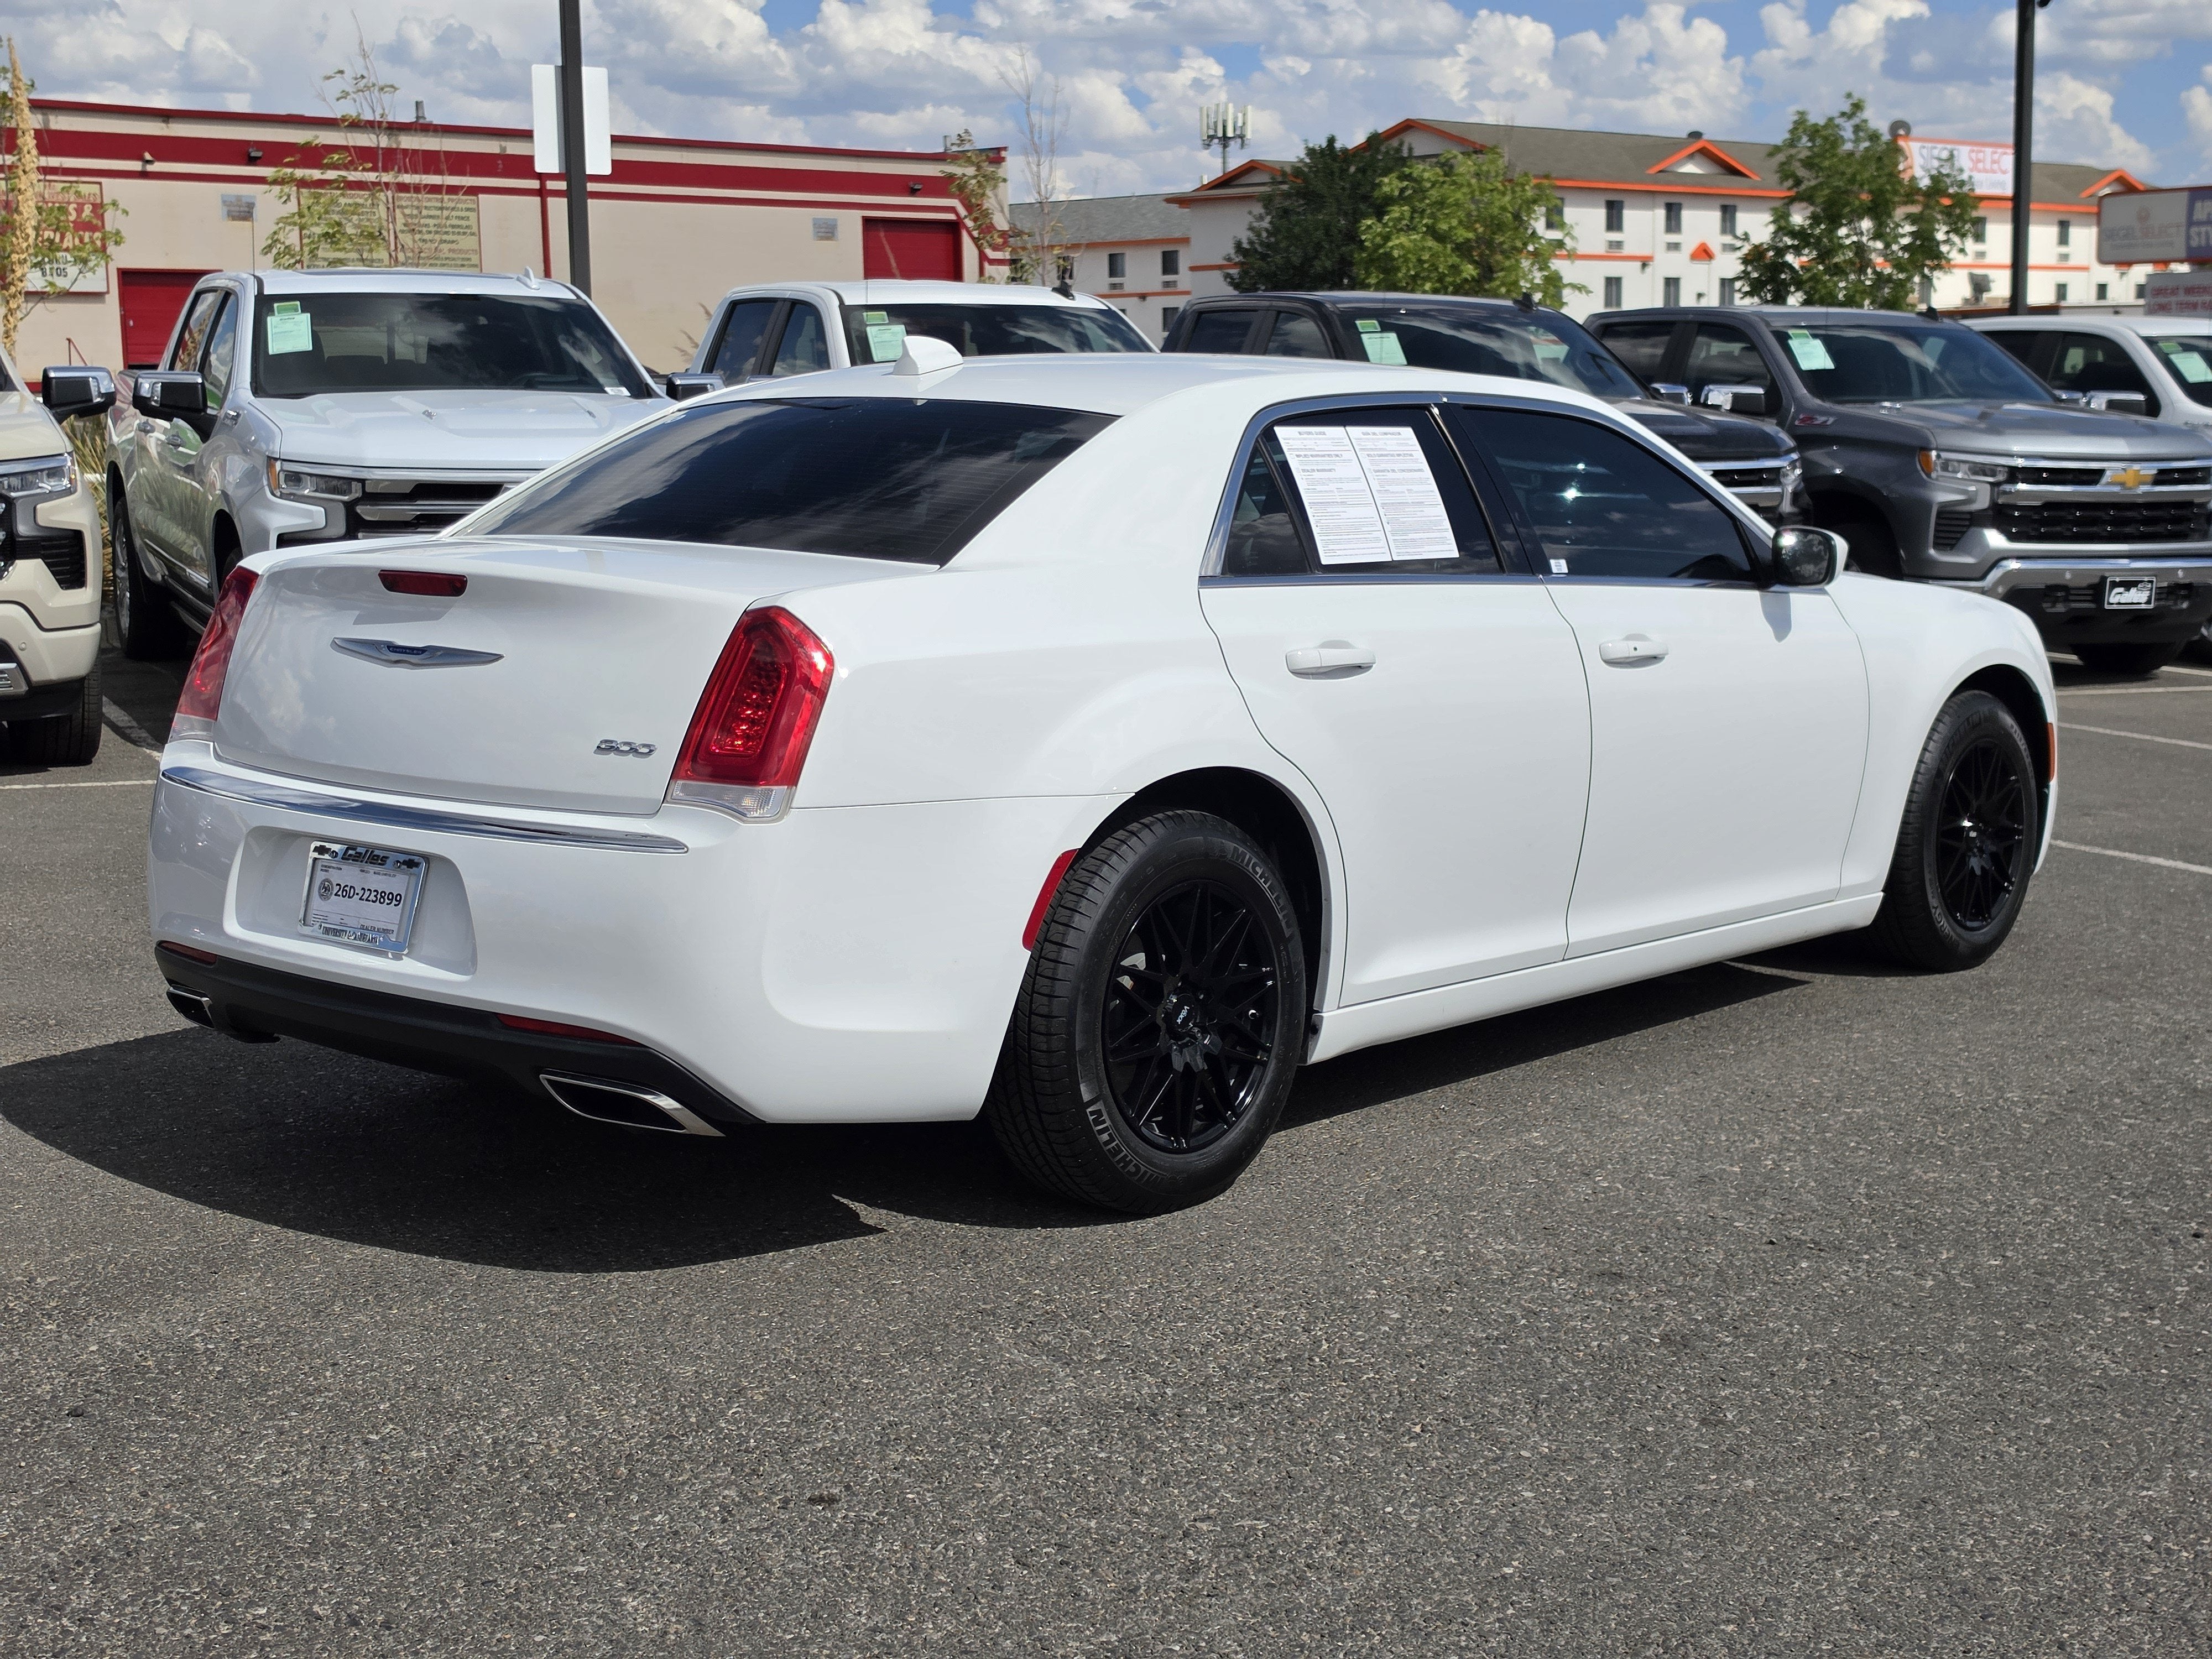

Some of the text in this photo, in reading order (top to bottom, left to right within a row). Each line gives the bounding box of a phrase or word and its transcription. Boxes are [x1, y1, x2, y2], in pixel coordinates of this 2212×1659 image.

[1968, 148, 2013, 175] SELEC
[596, 739, 658, 757] 300
[341, 846, 390, 867] Galles
[334, 883, 403, 907] 26D-223899
[1230, 844, 1300, 938] MICHELIN
[376, 926, 394, 935] NUMBER
[1087, 1107, 1165, 1188] MICHELIN
